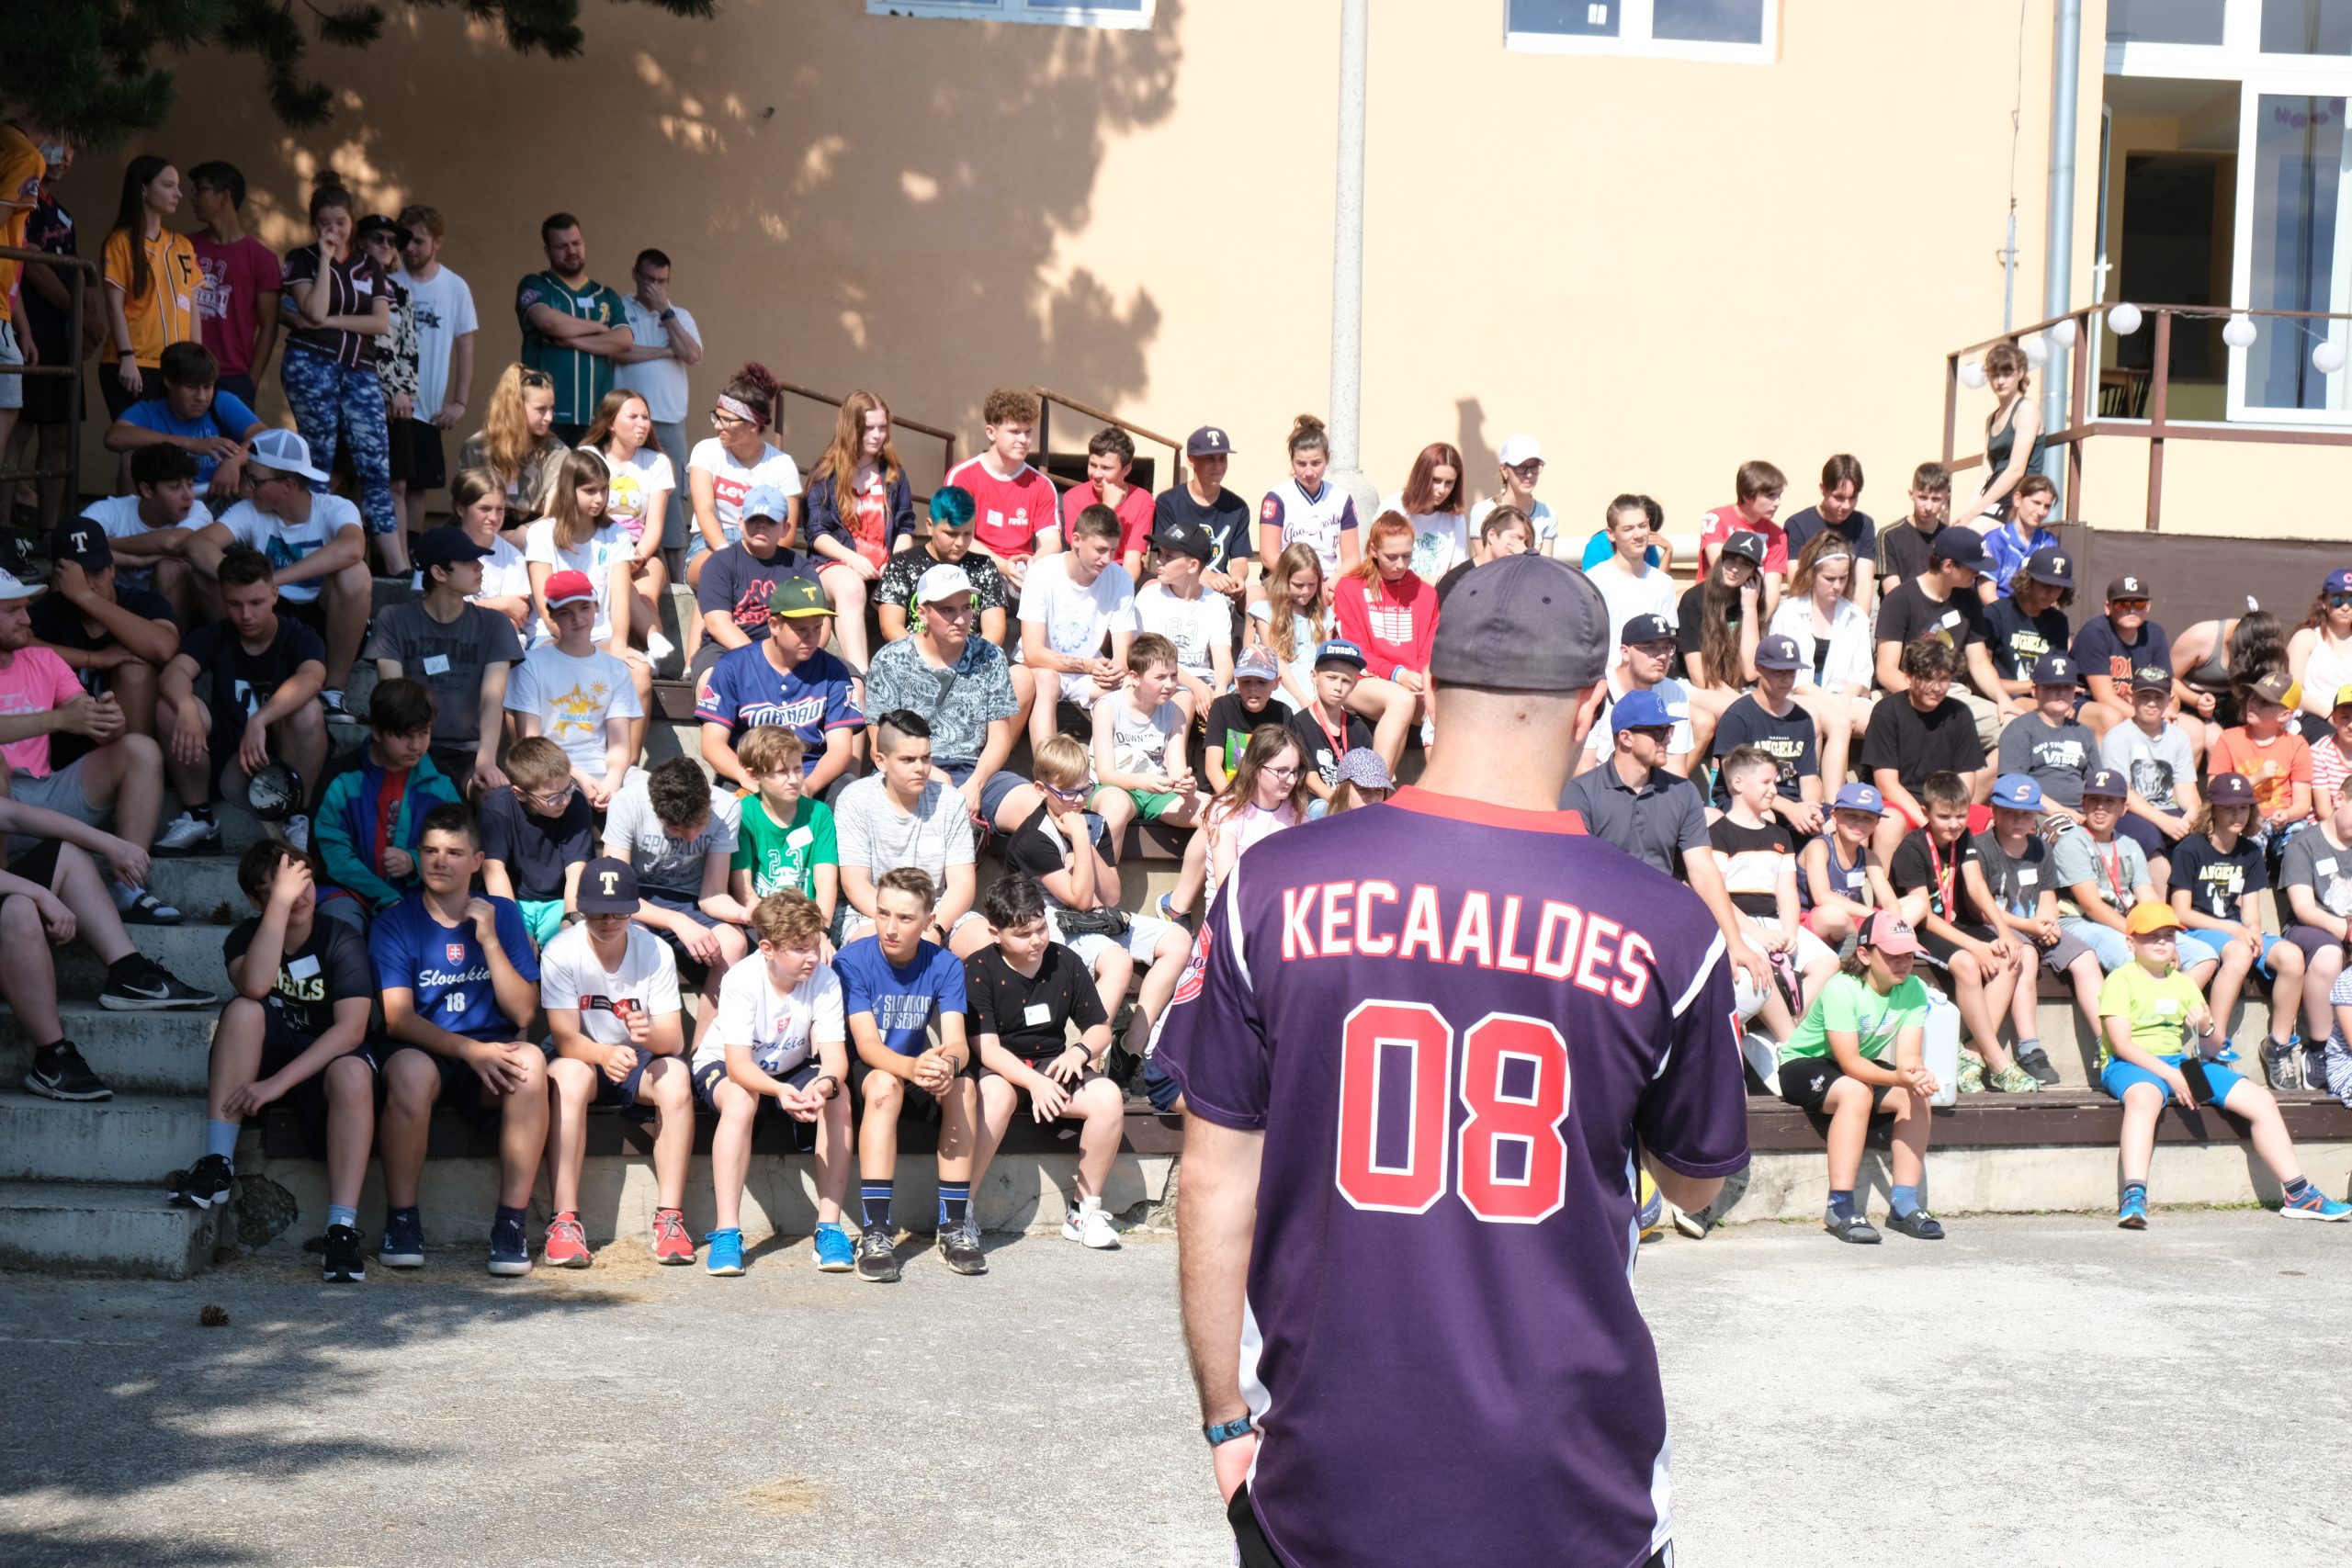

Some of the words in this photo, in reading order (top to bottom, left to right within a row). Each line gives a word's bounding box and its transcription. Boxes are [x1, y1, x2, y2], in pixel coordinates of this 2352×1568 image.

[1208, 431, 1220, 446] T
[70, 531, 89, 553] T
[2052, 557, 2065, 574] T
[802, 586, 817, 601] T
[1652, 616, 1666, 633] T
[1781, 641, 1794, 659] T
[2052, 659, 2066, 676] T
[2096, 772, 2110, 787] T
[1857, 789, 1874, 804] S
[2013, 784, 2031, 801] S
[599, 871, 619, 896] T
[1281, 879, 1657, 1009] KECAALDES
[445, 991, 466, 1013] 18
[1335, 998, 1572, 1225] 08
